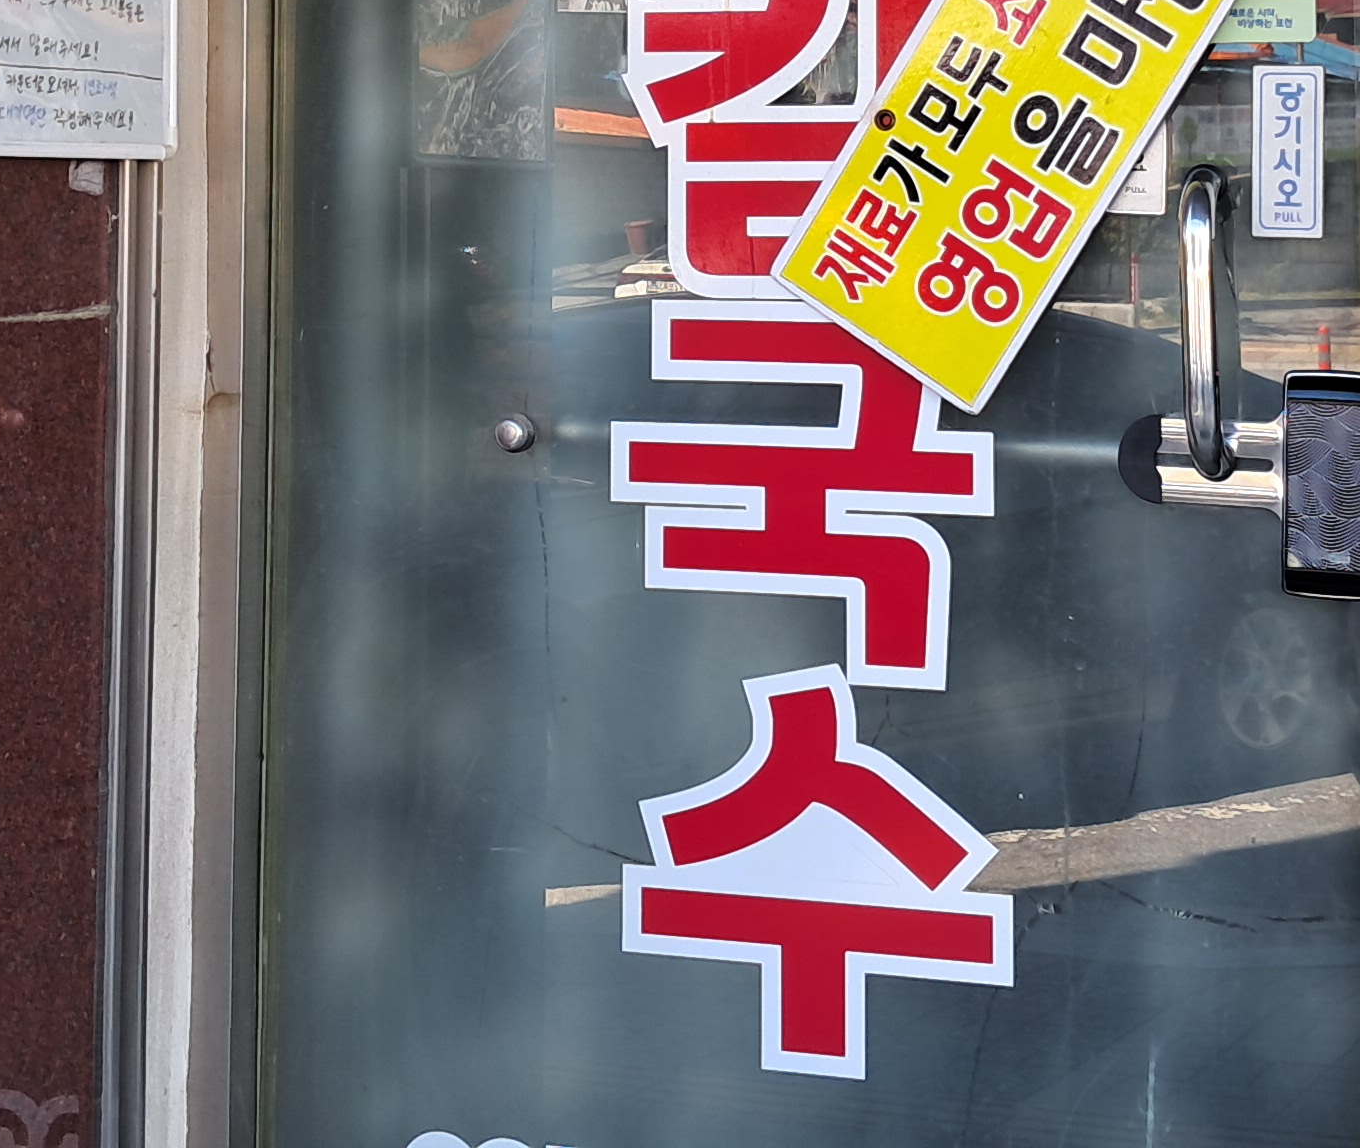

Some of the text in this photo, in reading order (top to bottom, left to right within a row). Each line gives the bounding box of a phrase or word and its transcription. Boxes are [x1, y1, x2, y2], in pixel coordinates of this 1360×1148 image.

[810, 134, 950, 305] 재료가
[907, 35, 1011, 155] 모두
[916, 94, 1122, 325] 영업을
[1273, 82, 1305, 208] 당기시오
[1274, 211, 1303, 223] PULL
